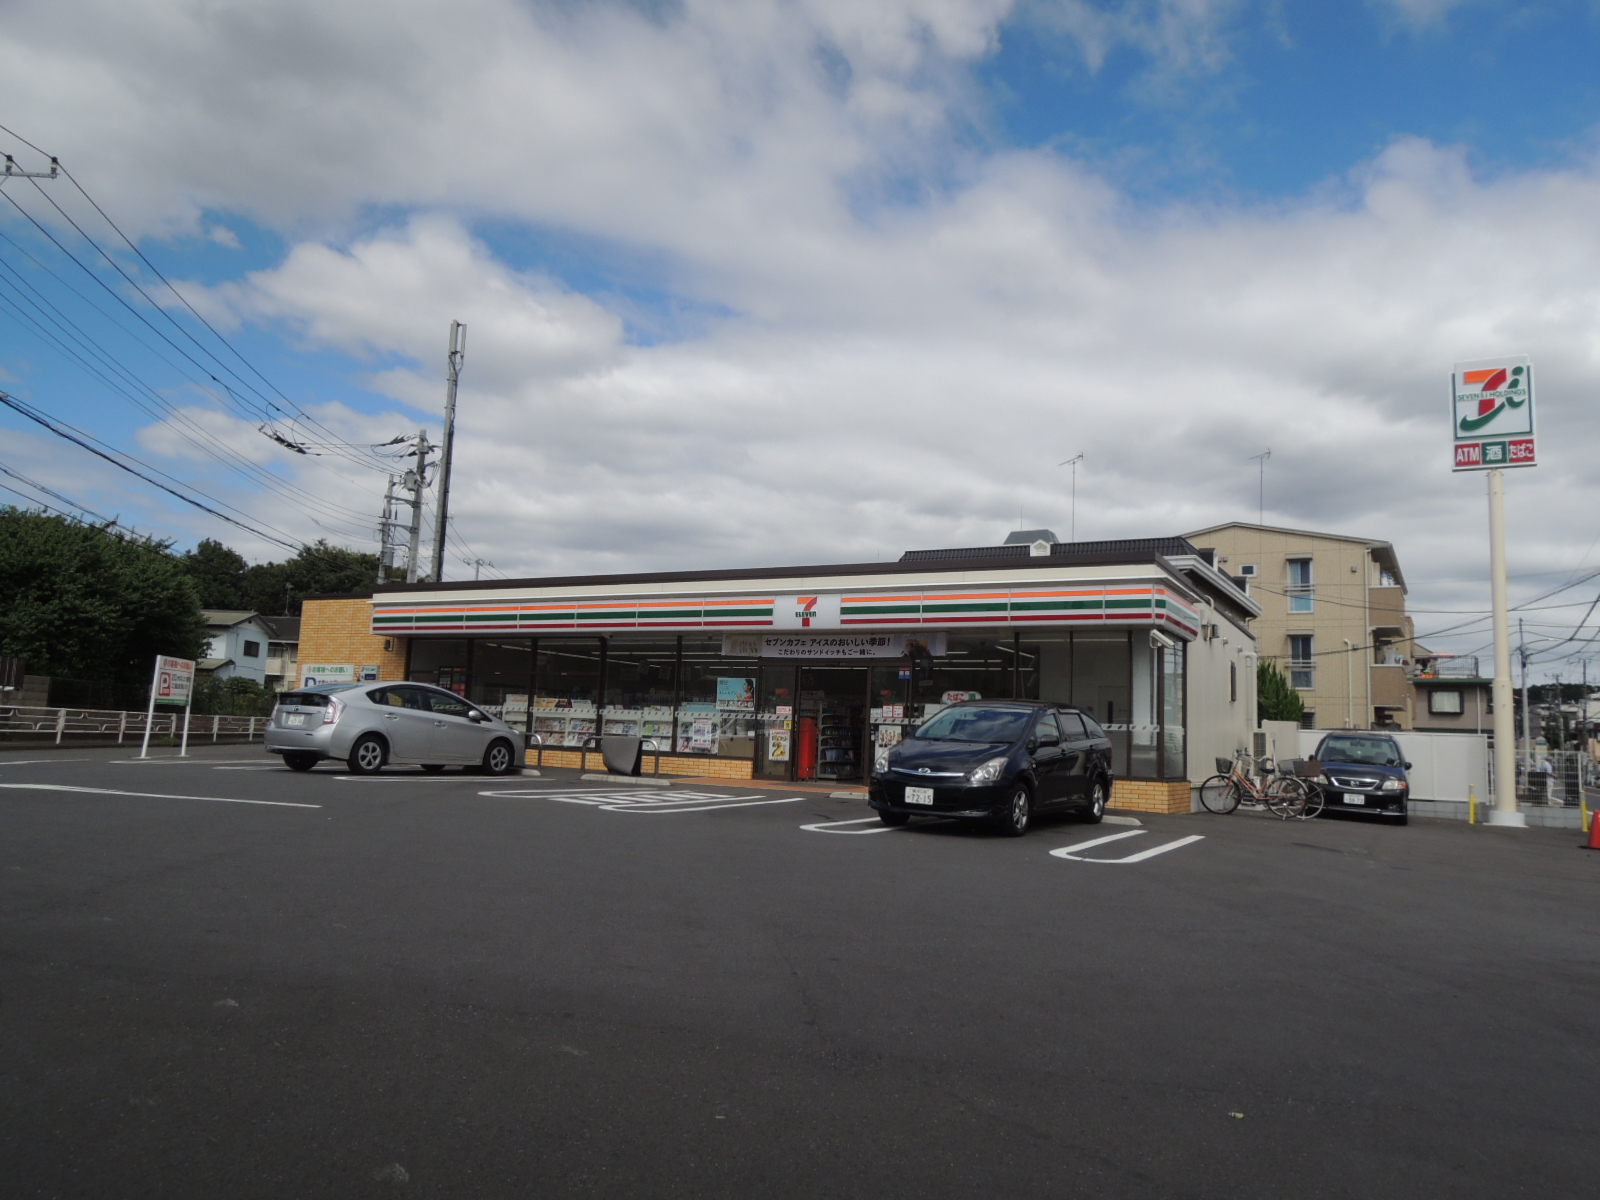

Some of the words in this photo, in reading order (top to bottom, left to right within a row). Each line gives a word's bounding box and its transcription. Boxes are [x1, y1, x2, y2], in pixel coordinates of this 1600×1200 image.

[1489, 388, 1527, 399] HOLDINGS
[1456, 447, 1479, 463] ATM
[1486, 445, 1503, 460] 酒
[1509, 443, 1534, 459] たばこ
[764, 638, 807, 647] セブンカフェ
[946, 692, 965, 702] たばこ
